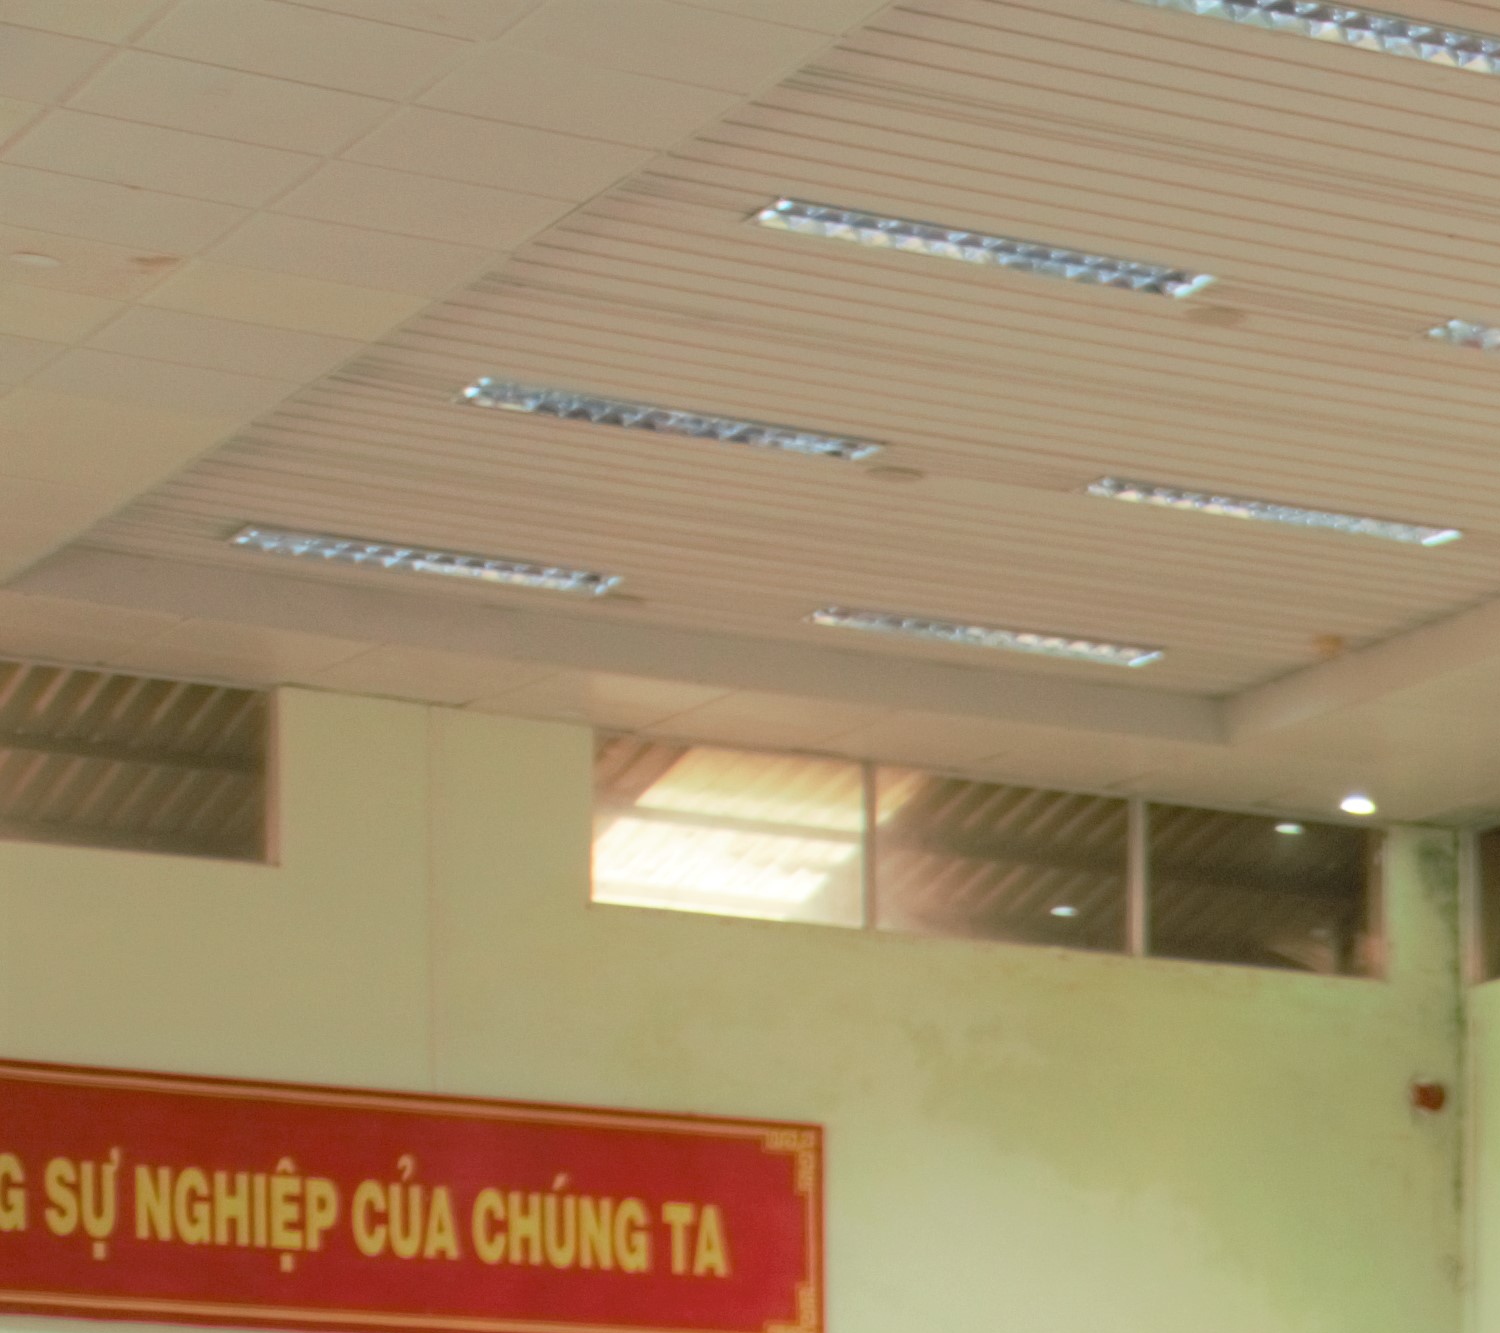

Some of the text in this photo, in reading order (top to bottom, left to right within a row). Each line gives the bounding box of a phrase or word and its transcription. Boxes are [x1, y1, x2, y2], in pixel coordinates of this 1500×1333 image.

[43, 1146, 122, 1261] SỰ
[134, 1158, 338, 1273] NGHIỆP
[352, 1155, 460, 1261] CỦA
[472, 1174, 651, 1275] CHÚNG
[663, 1201, 732, 1278] TA
